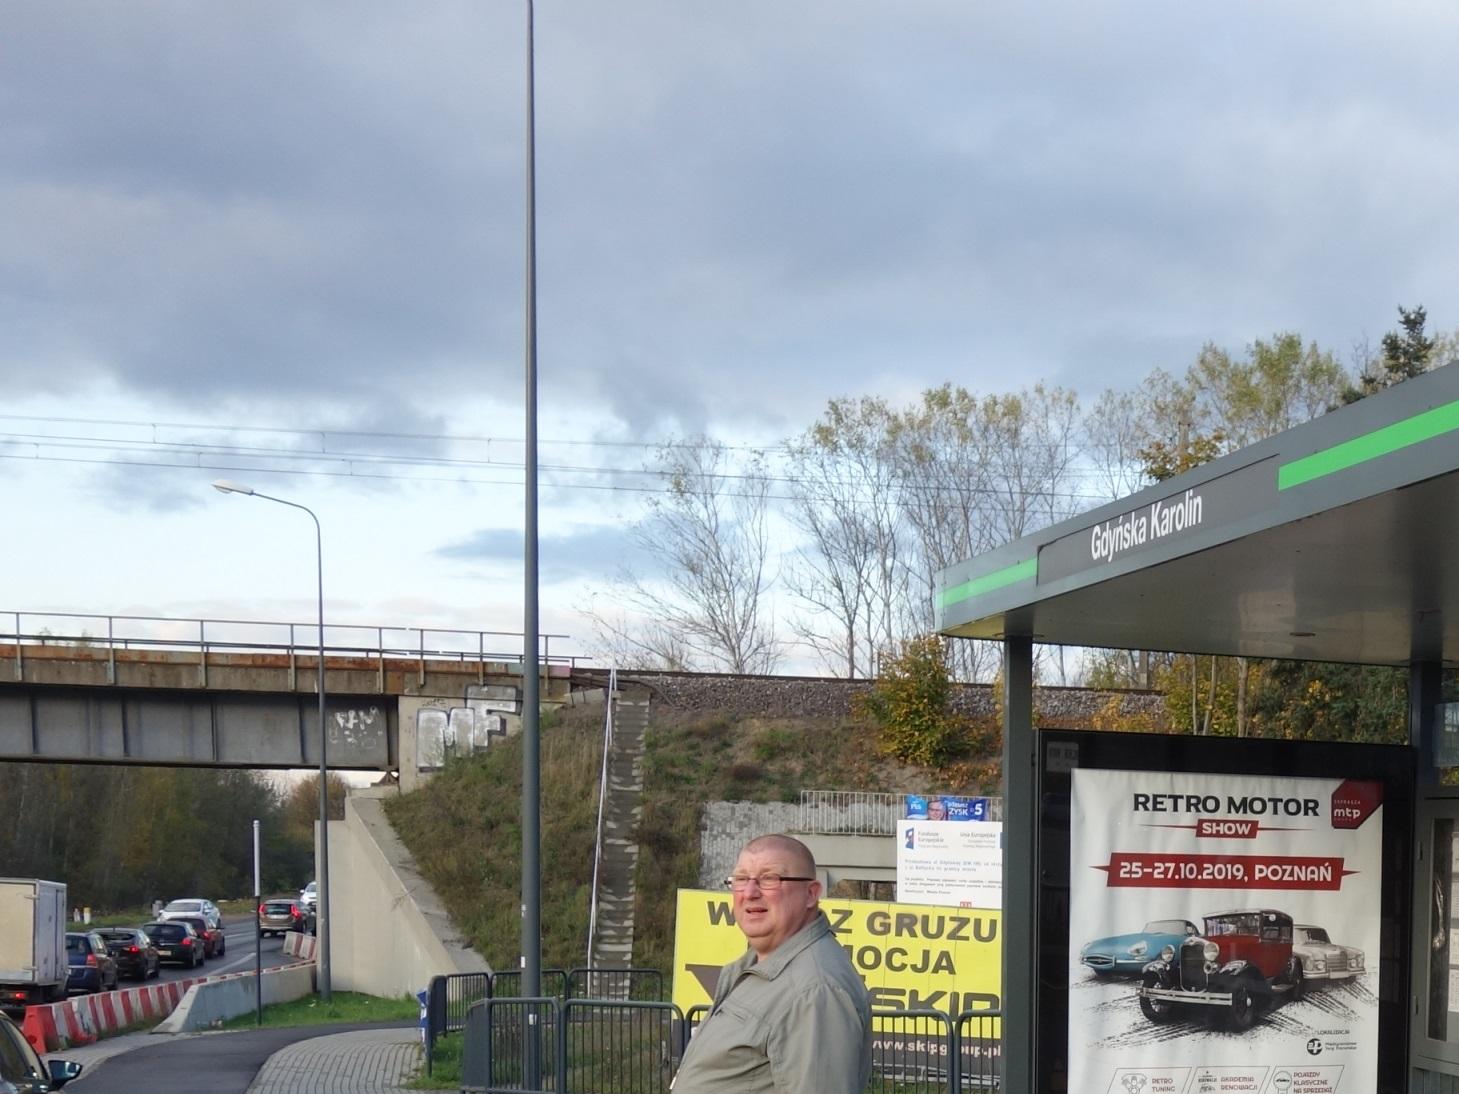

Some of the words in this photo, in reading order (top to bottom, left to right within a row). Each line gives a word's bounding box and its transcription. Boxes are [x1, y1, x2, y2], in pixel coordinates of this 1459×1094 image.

[1091, 511, 1147, 562] Gdyńska
[1151, 489, 1202, 540] Karolin
[975, 804, 983, 815] 5
[1133, 793, 1220, 814] RETRO
[1227, 796, 1320, 817] MOTOR
[1334, 808, 1361, 819] mtp
[1202, 822, 1252, 835] SHOW
[1119, 861, 1248, 883] 25-27.10.2019,
[1255, 862, 1332, 882] POZNAŃ
[866, 910, 998, 943] GRUZU
[843, 944, 957, 976] OCJA
